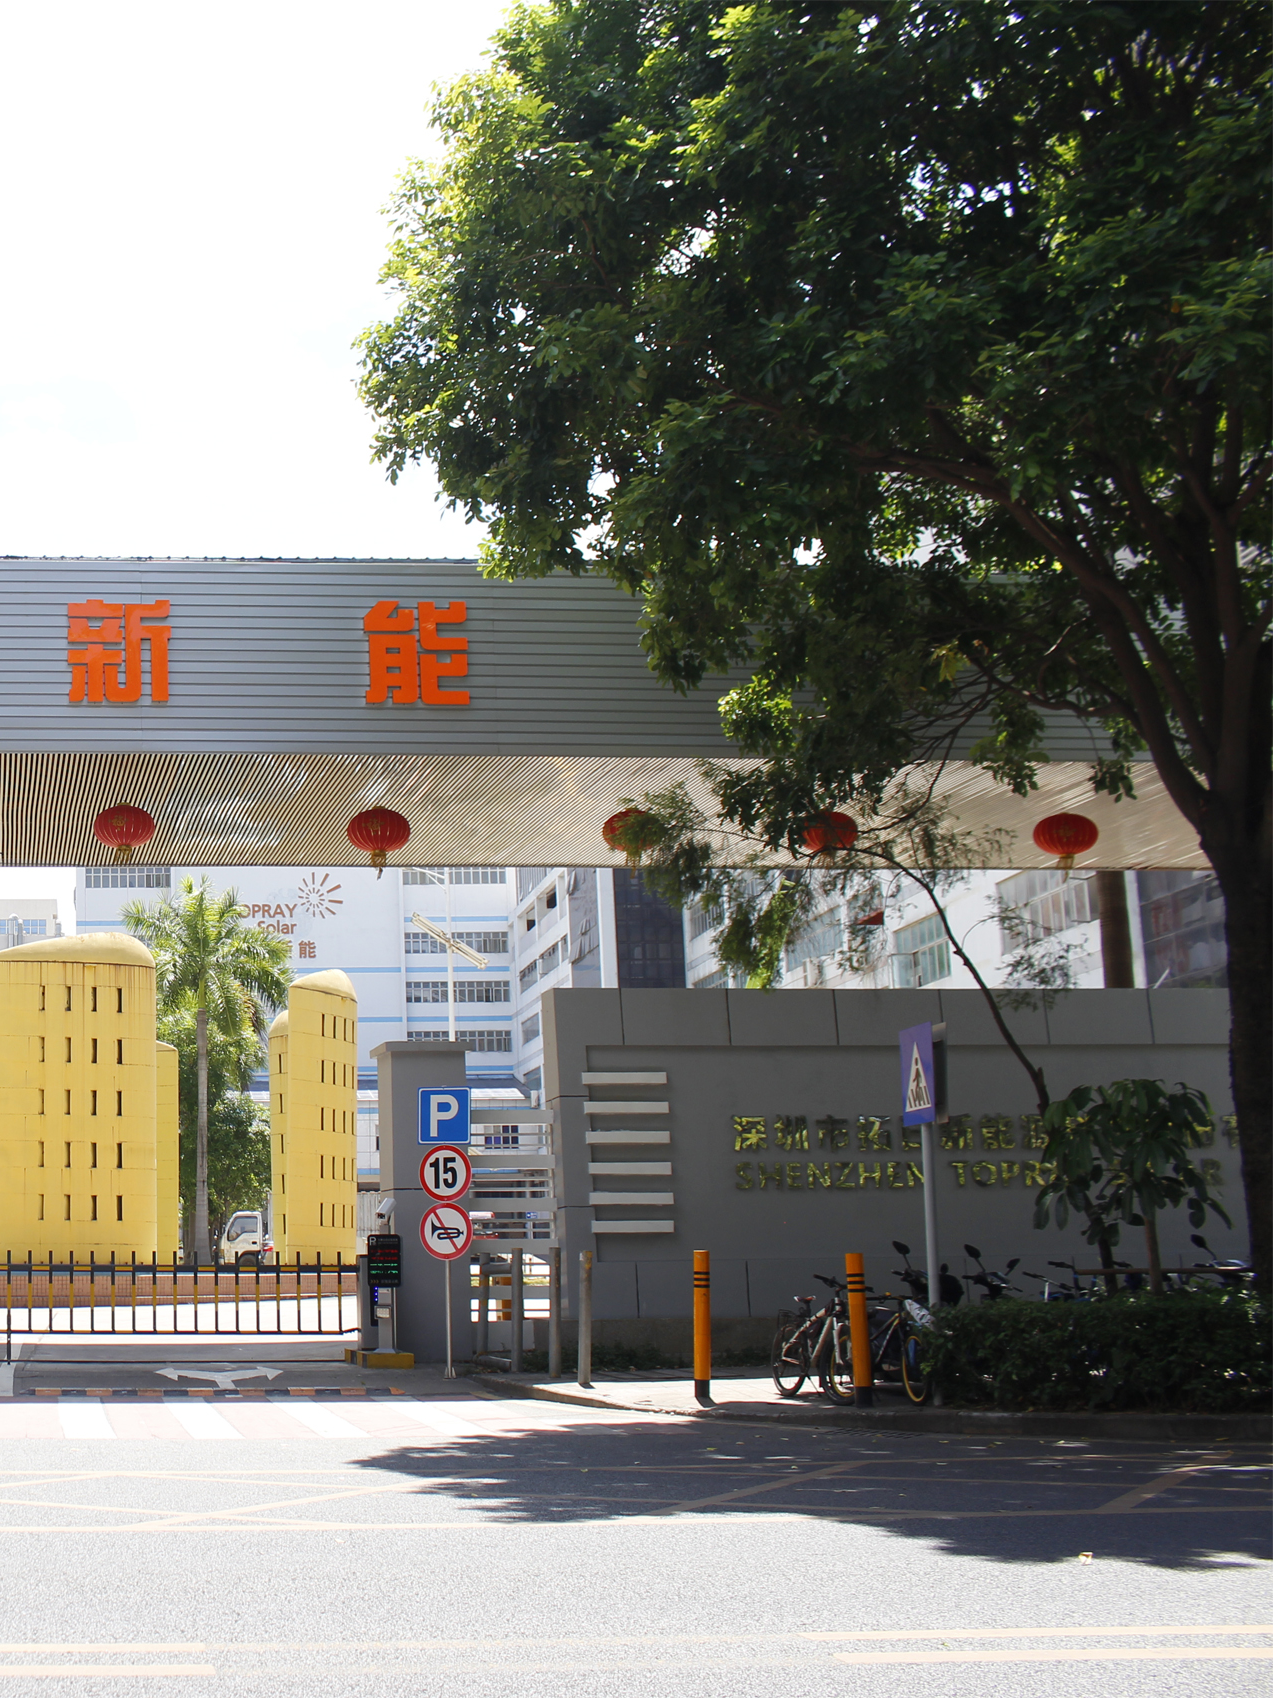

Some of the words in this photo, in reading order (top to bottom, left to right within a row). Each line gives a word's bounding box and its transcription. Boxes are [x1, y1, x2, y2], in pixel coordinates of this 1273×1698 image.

[238, 903, 298, 918] OPRAY
[258, 919, 297, 934] Solar
[430, 1094, 459, 1137] P
[429, 1157, 458, 1189] 15
[735, 1161, 925, 1190] SHENZHEN
[951, 1160, 1060, 1188] TOPR
